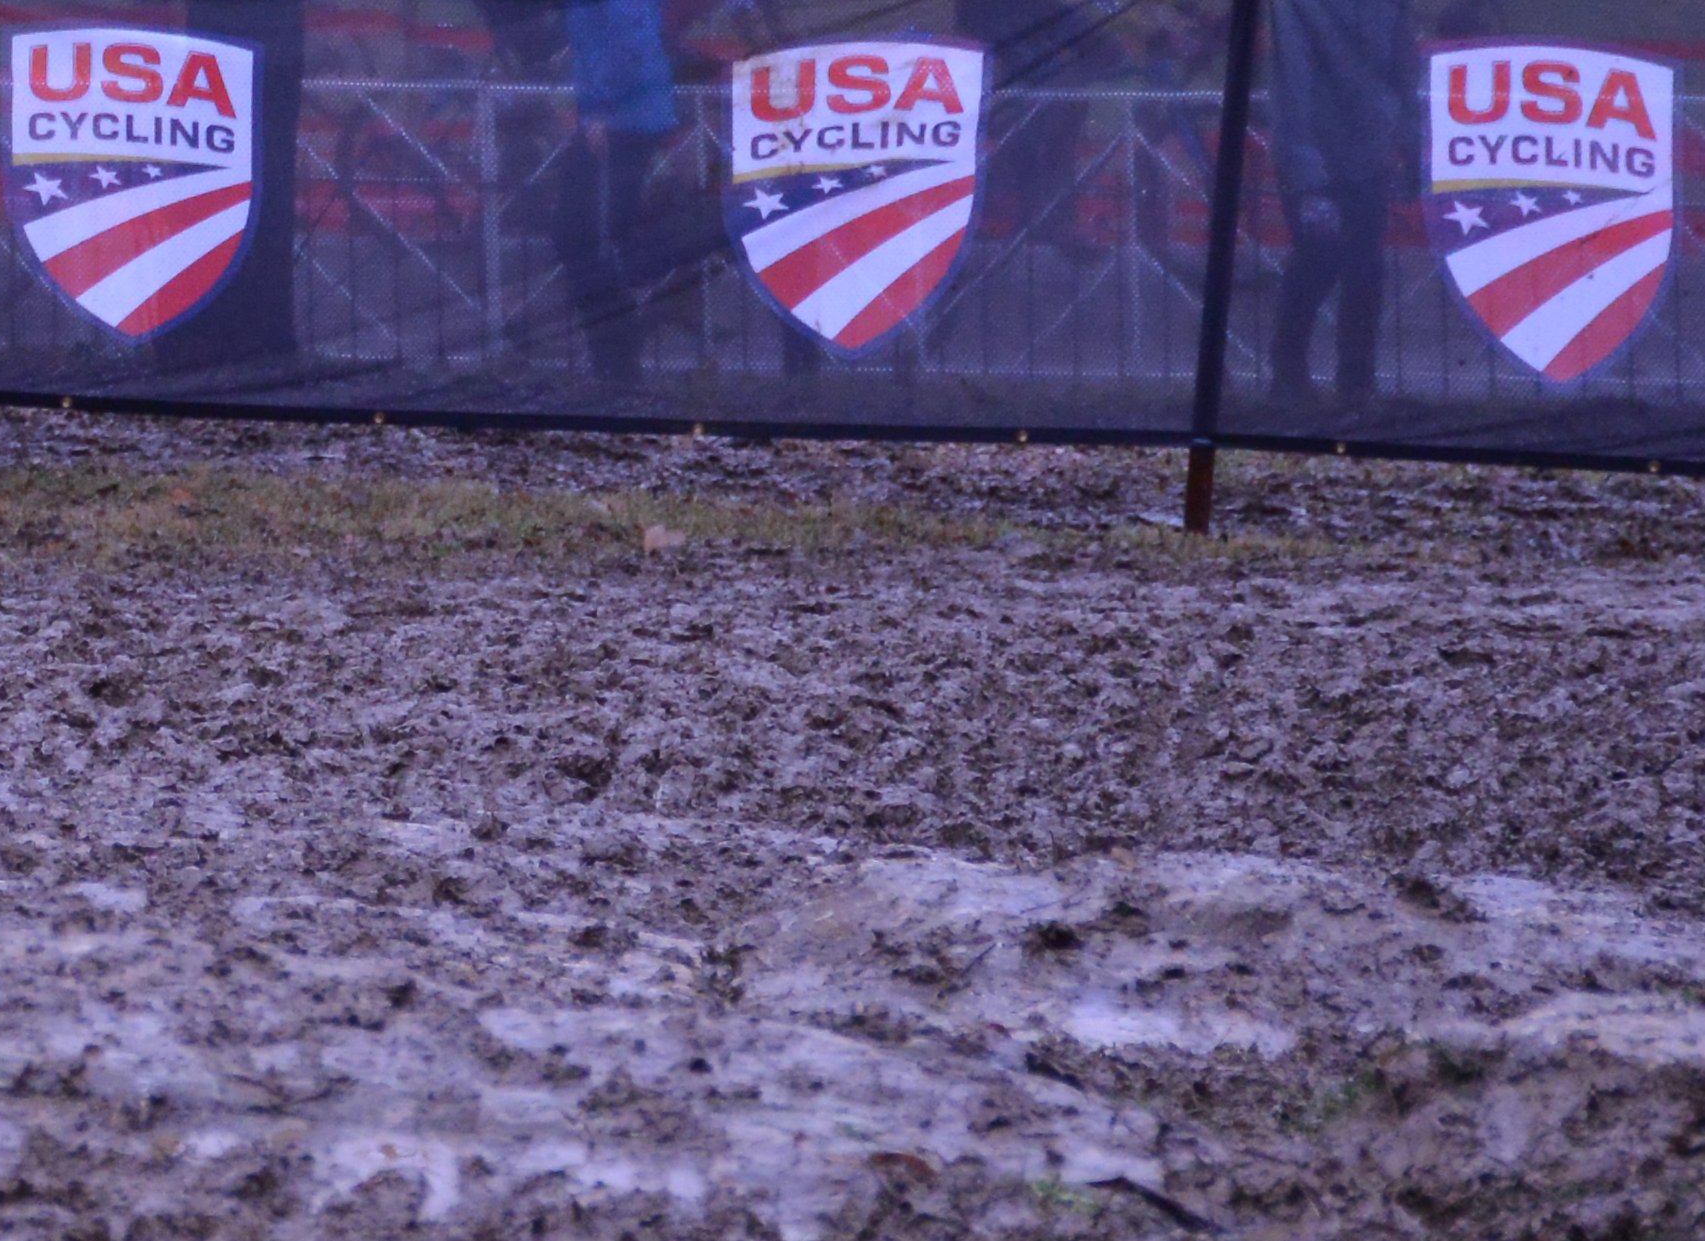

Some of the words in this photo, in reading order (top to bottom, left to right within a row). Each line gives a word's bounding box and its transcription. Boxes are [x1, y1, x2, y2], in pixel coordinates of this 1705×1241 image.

[29, 42, 237, 119] USA
[750, 54, 964, 122] USA
[1448, 60, 1657, 141] USA
[28, 111, 236, 153] CYCLING
[750, 120, 963, 160] CYCLING
[1448, 134, 1656, 178] CYCLING
